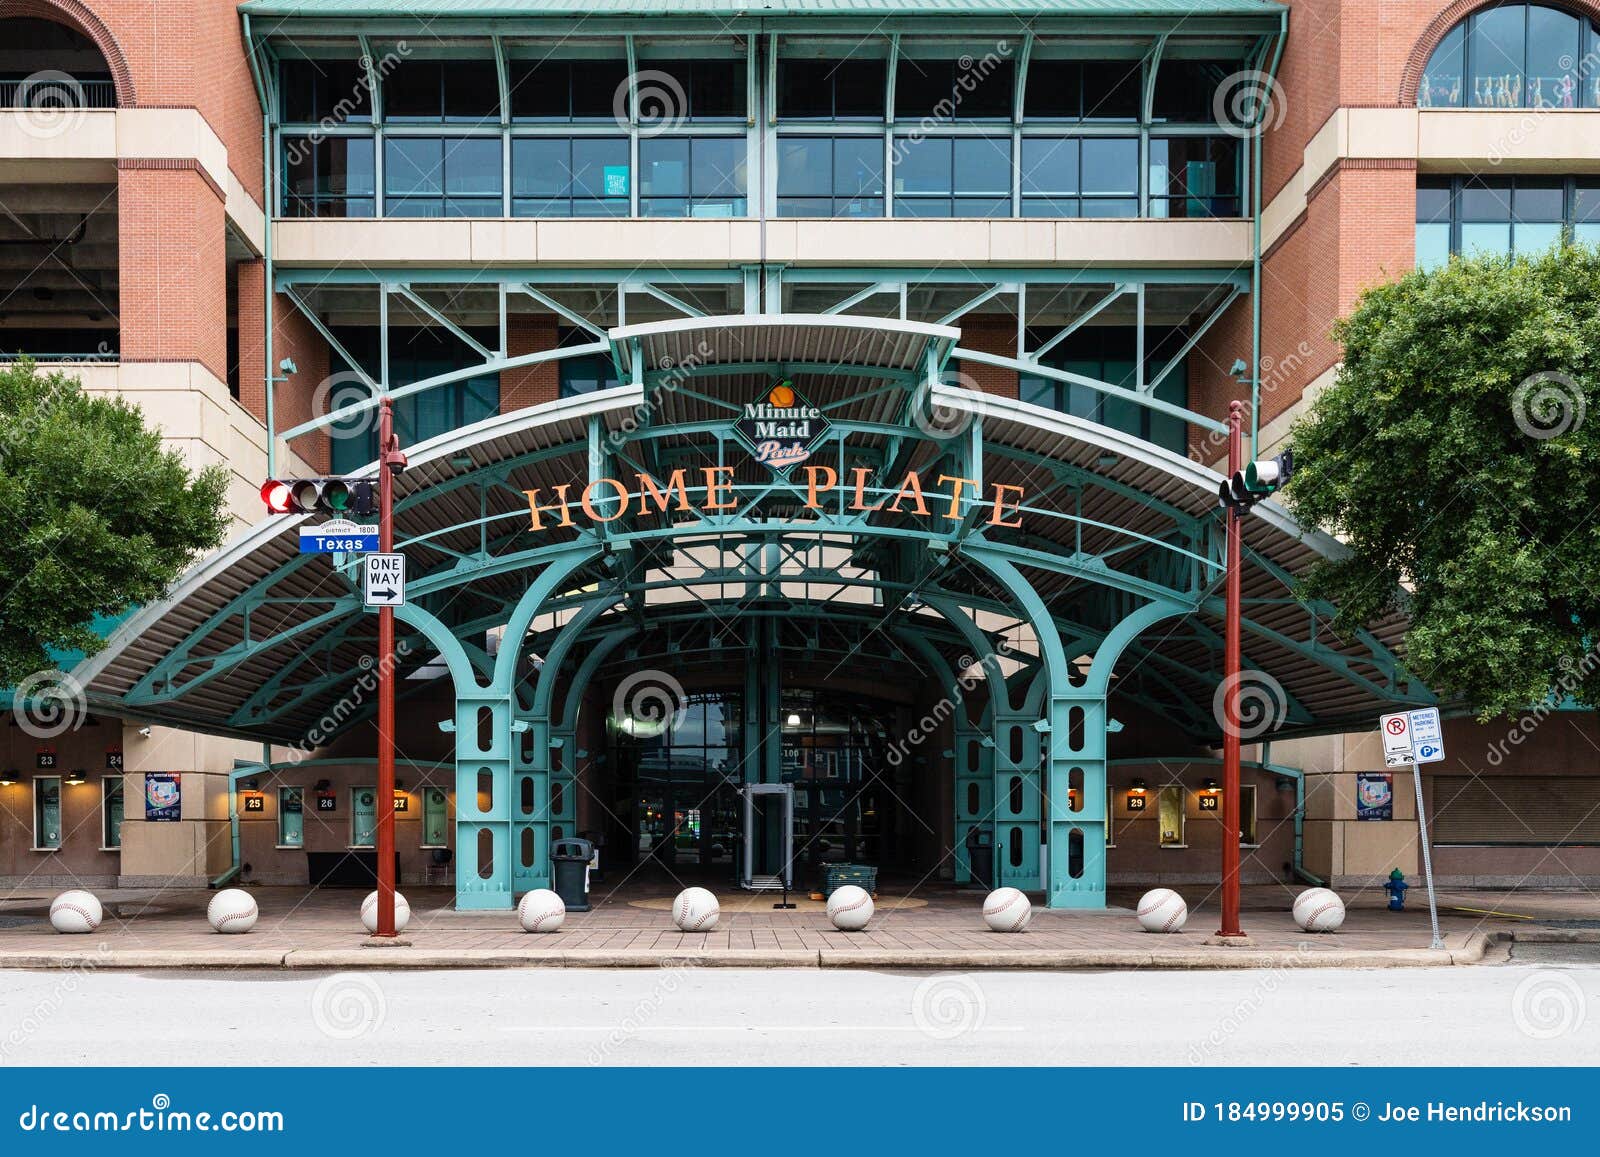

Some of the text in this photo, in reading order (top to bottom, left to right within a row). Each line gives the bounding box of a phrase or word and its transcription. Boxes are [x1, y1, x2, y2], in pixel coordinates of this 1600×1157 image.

[744, 403, 821, 420] Minute
[755, 421, 811, 438] Maid
[755, 440, 811, 465] Park
[522, 466, 1025, 532] HOME PLATE
[316, 538, 363, 550] Texas
[371, 558, 400, 570] ONE
[370, 572, 400, 584] WAY
[41, 756, 53, 765] 23
[110, 756, 122, 765] 24
[249, 799, 261, 808] 25
[321, 799, 333, 808] 26
[394, 799, 405, 808] 27
[1131, 798, 1143, 808] 29
[1203, 798, 1215, 808] 30
